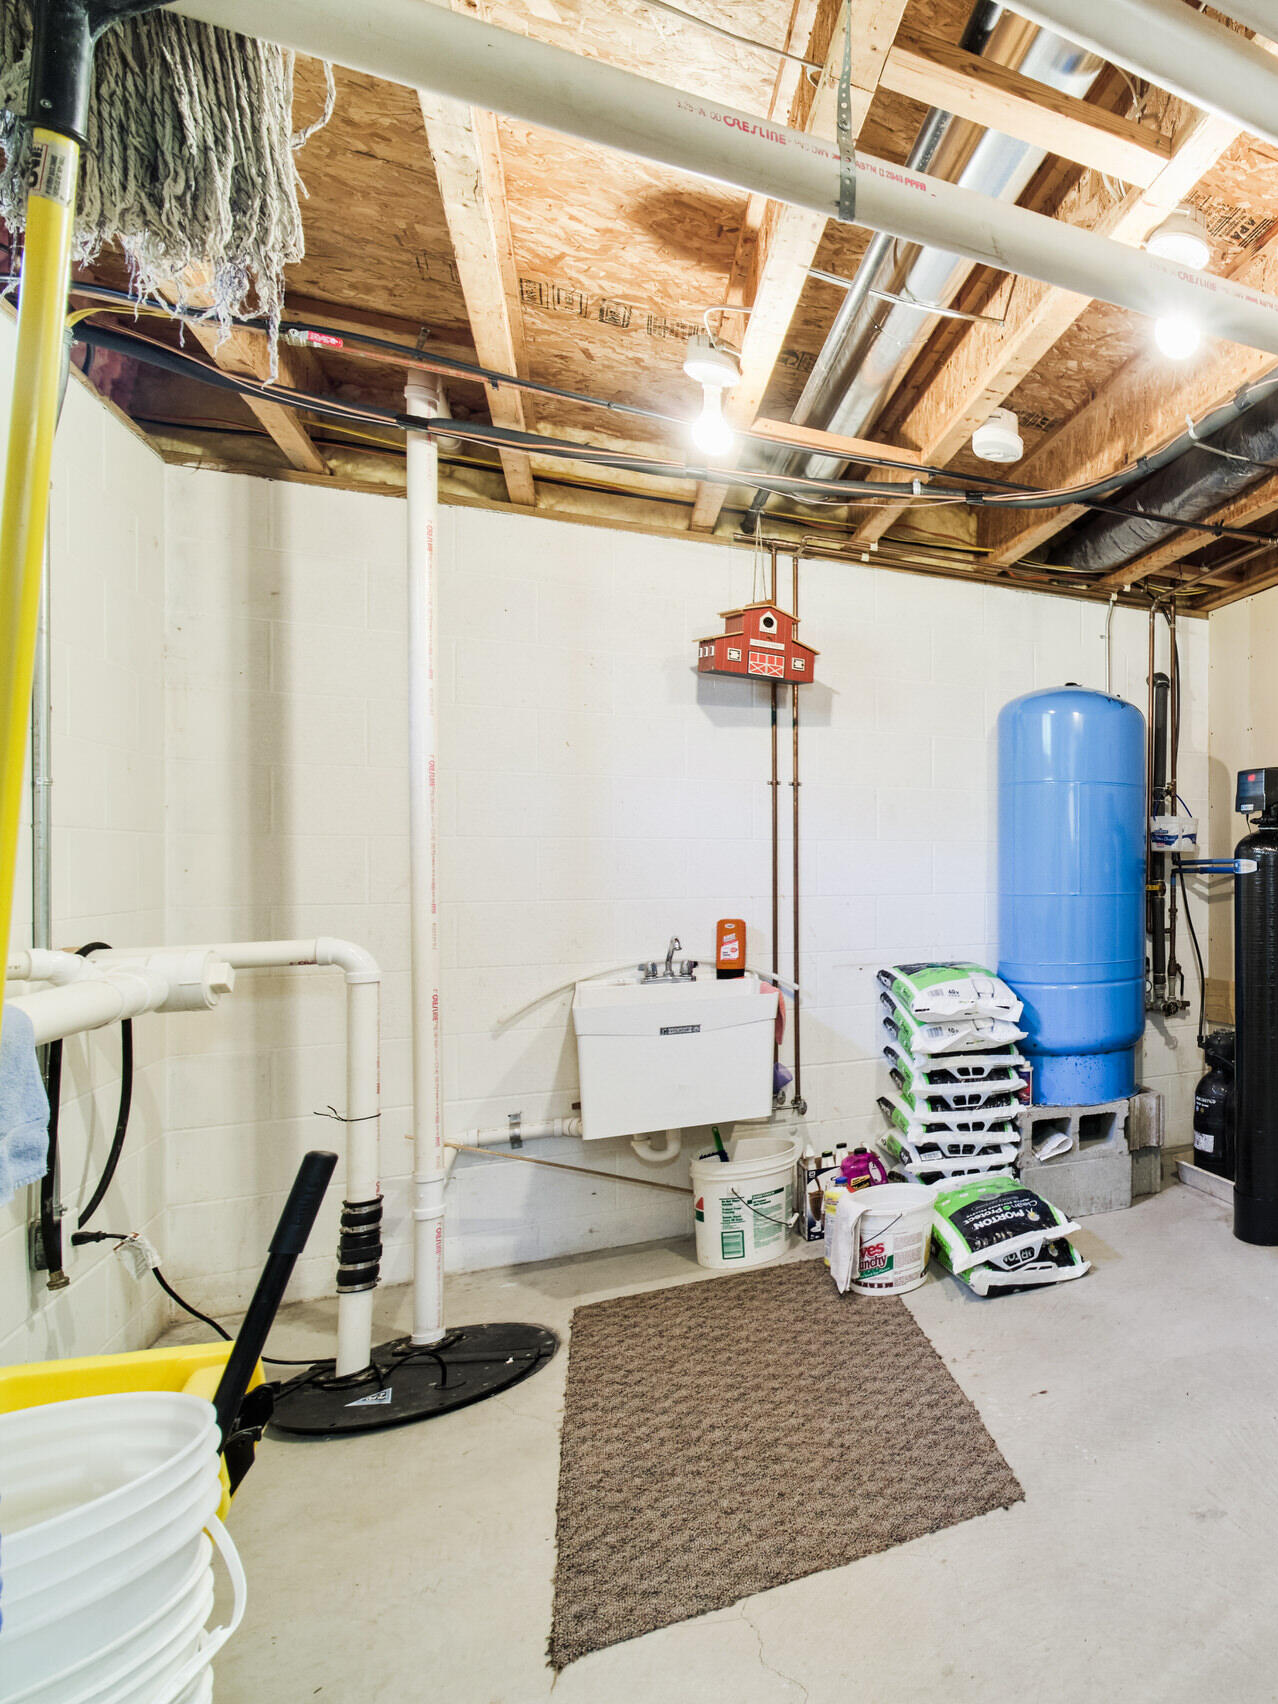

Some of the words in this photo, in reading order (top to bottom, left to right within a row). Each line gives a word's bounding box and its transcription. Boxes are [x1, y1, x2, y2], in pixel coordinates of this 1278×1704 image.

[963, 1207, 1004, 1224] Protect
[974, 1210, 1025, 1231] MORTON
[859, 1255, 887, 1270] unchy
